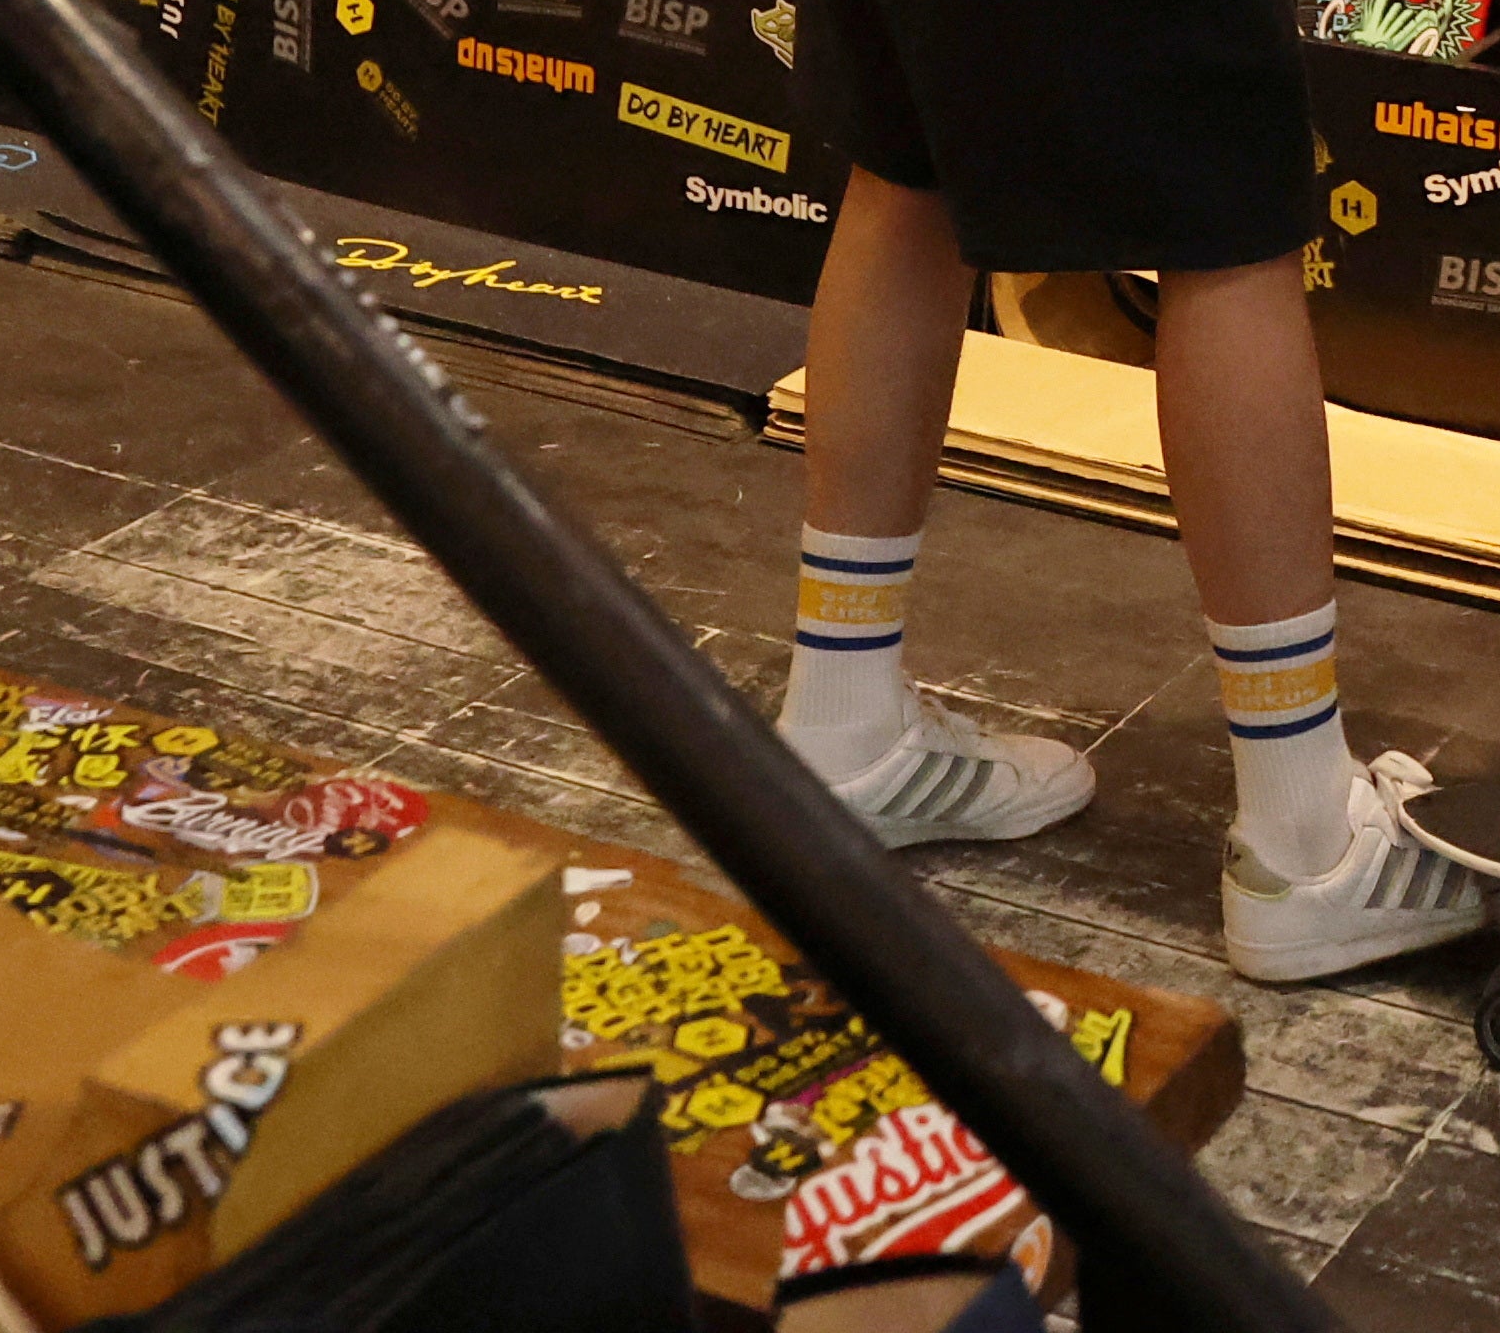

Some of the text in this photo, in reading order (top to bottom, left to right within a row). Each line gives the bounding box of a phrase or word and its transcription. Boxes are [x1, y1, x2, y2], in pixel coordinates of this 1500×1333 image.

[217, 3, 239, 39] BY
[197, 40, 231, 129] HEART
[456, 34, 597, 95] whatsup
[625, 90, 786, 163] DO BY HEART
[685, 175, 830, 224] Symbolic
[60, 1019, 300, 1265] JUSTICE
